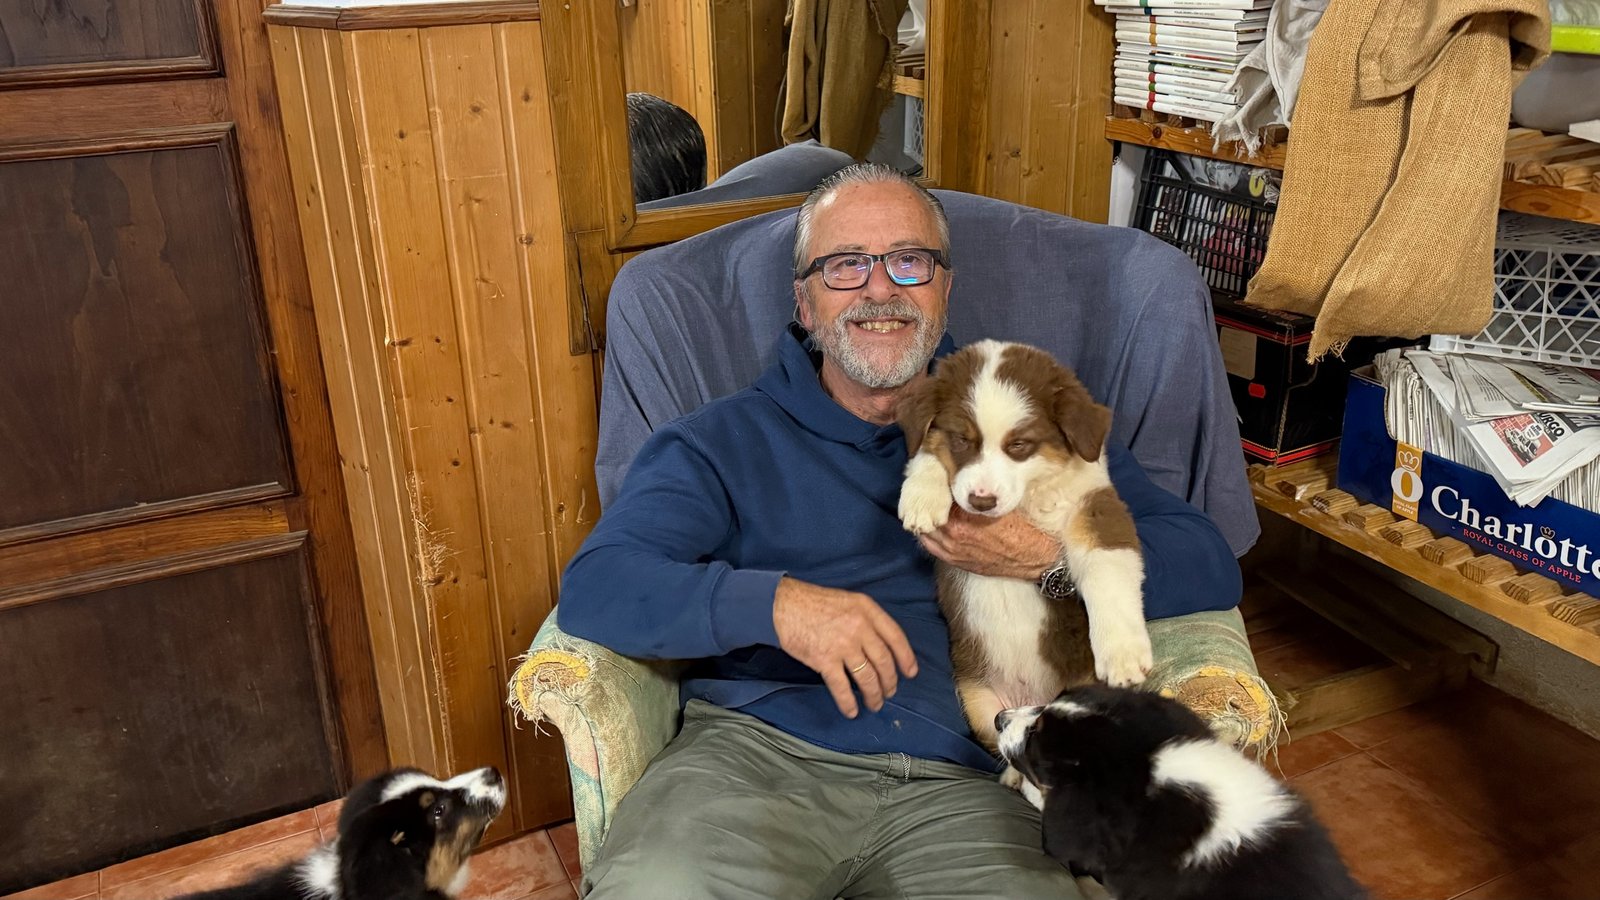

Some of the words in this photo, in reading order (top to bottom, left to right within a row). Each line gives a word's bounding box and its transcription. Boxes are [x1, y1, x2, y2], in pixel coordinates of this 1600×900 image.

[1463, 528, 1494, 547] ROYAL
[1496, 543, 1529, 561] CLASS
[1531, 557, 1546, 567] OF
[1548, 564, 1581, 583] APPLE
